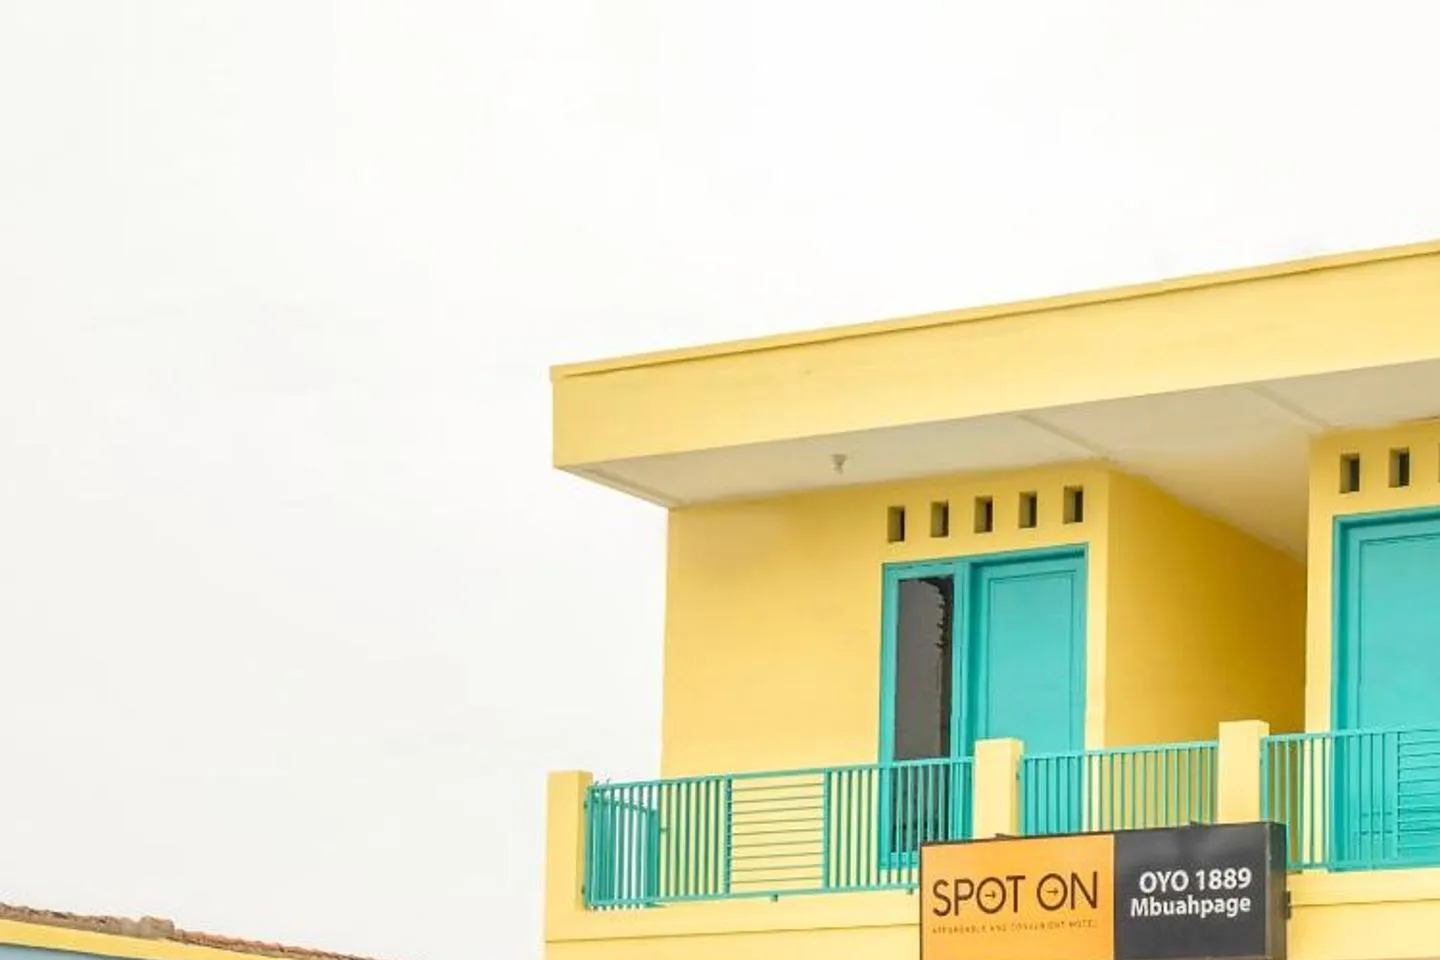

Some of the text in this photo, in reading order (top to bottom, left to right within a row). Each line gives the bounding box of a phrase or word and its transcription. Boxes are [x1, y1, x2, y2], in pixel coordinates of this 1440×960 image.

[1139, 867, 1252, 893] OYO 1889
[932, 871, 1098, 917] SPOT ON
[1130, 894, 1251, 919] Mbuahpage
